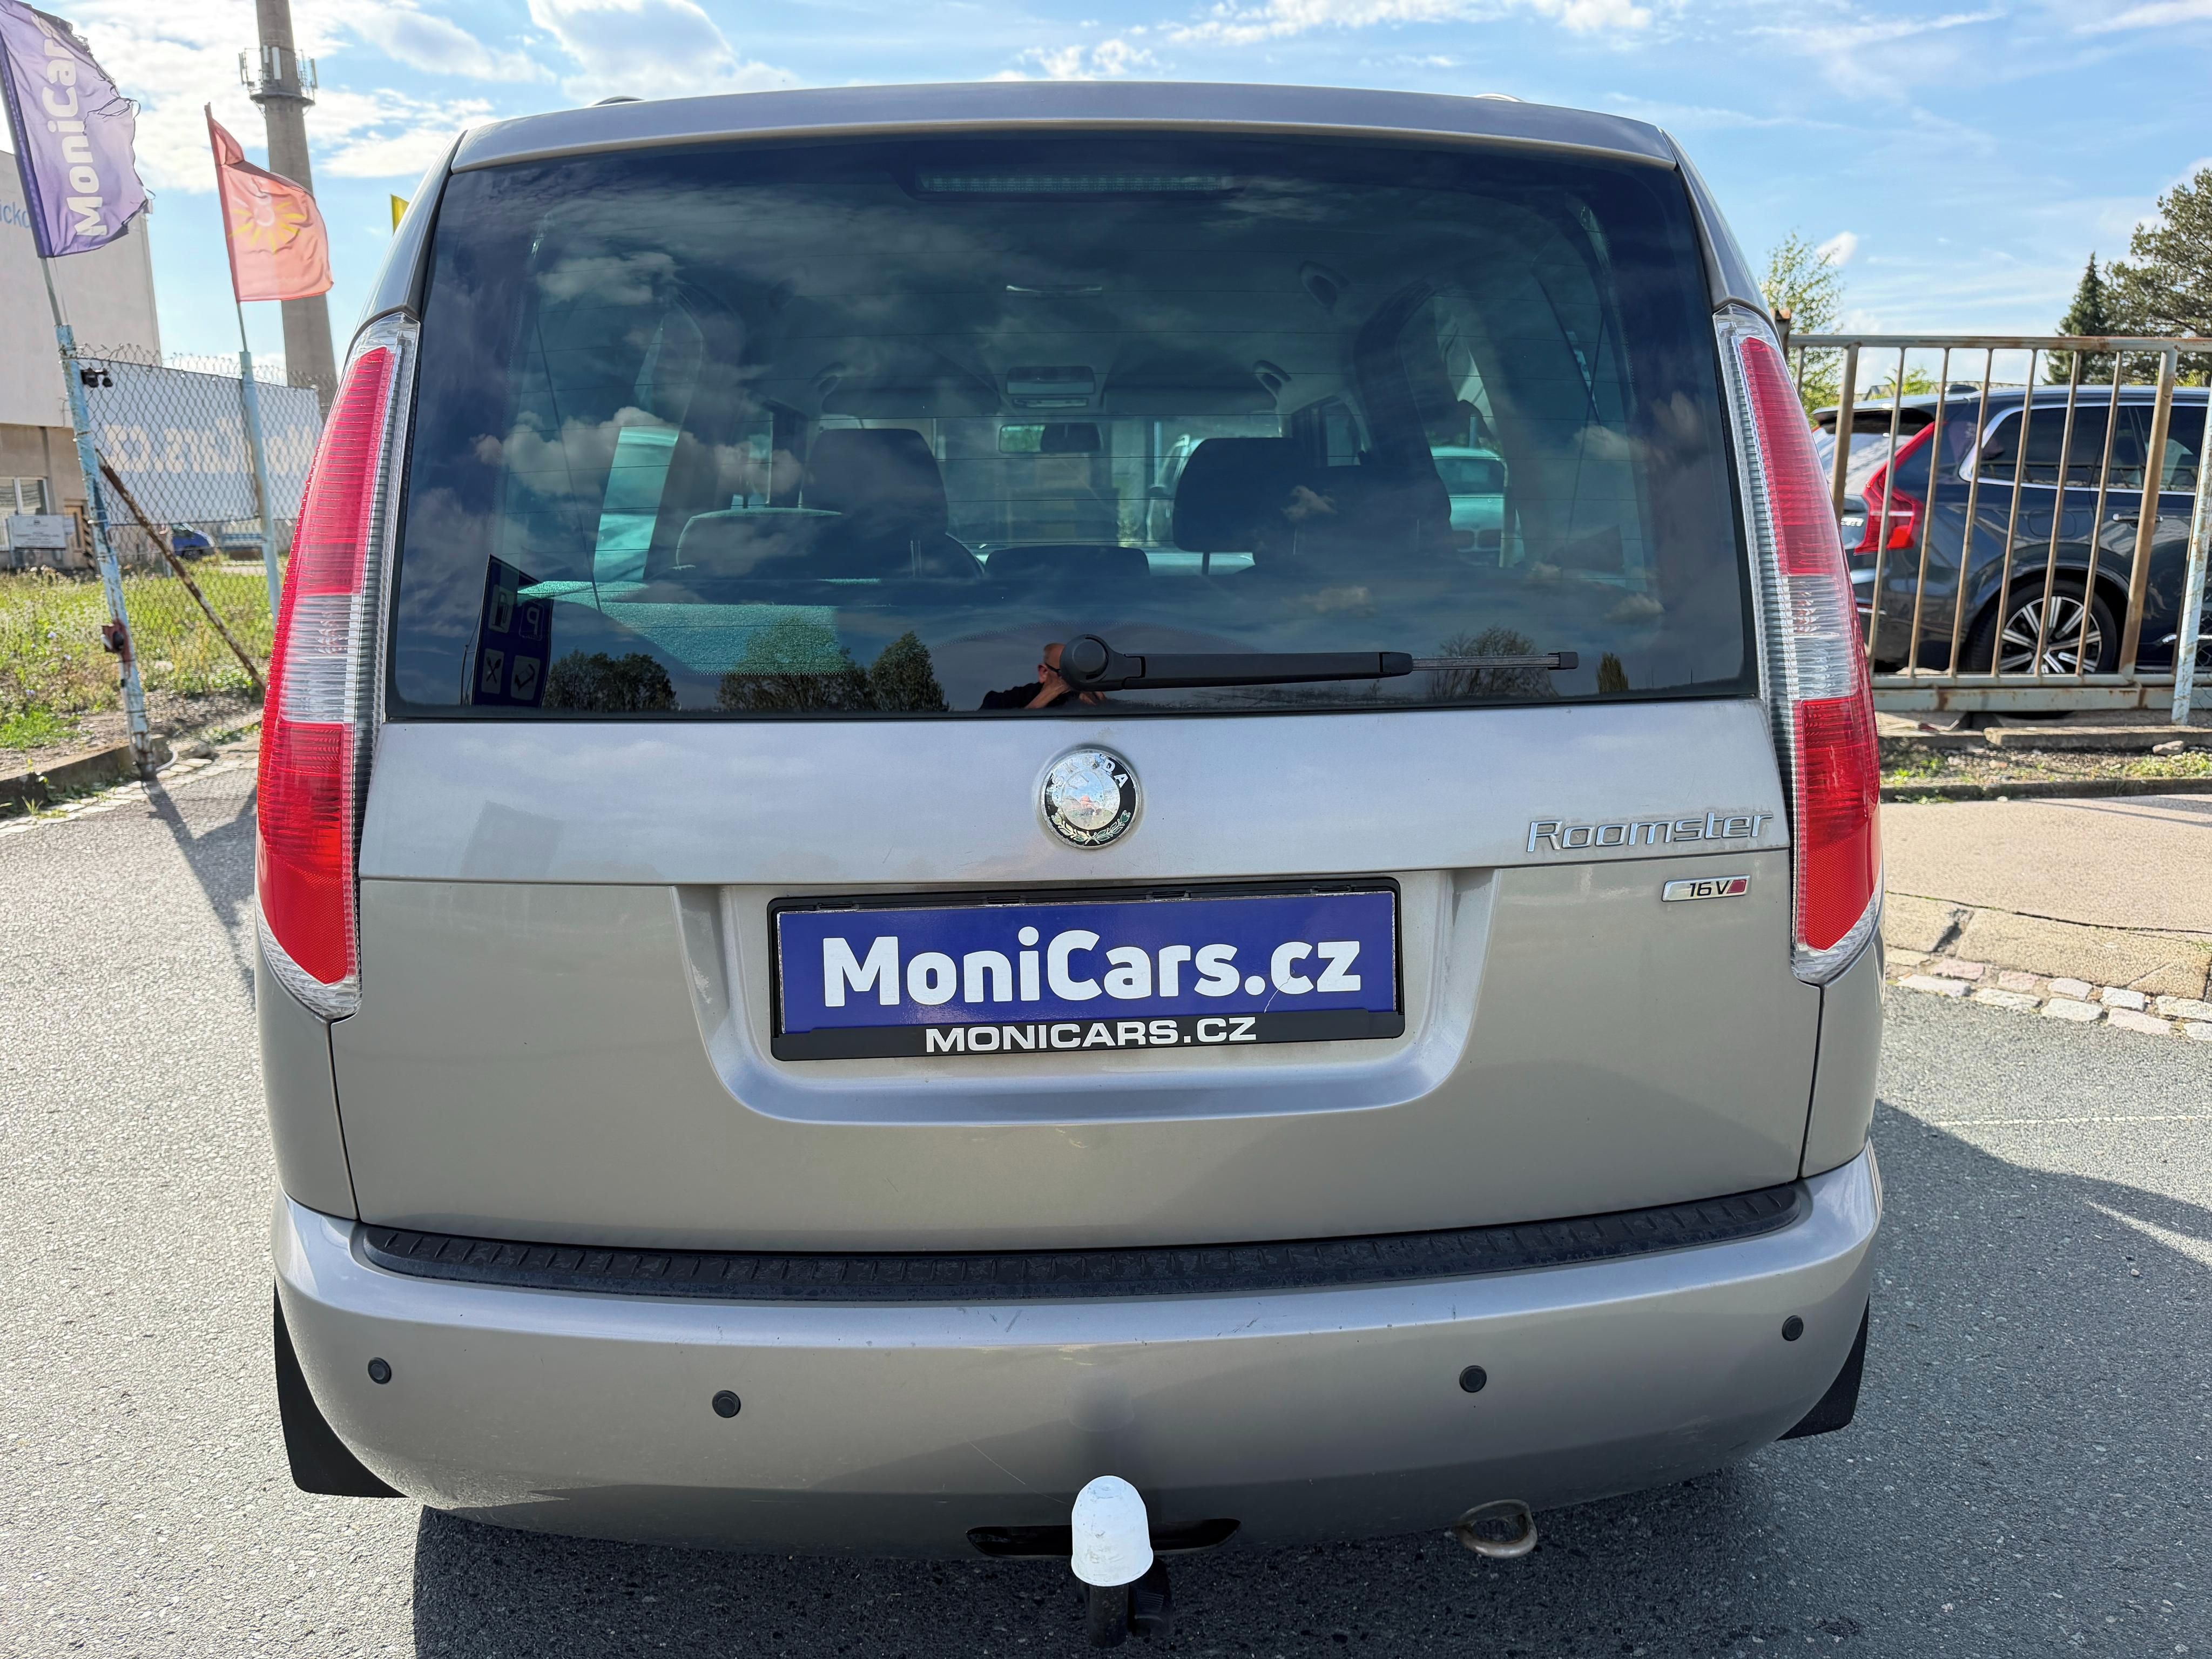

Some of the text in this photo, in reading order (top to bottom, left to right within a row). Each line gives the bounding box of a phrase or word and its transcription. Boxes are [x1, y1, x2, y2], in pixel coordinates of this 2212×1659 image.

[1526, 812, 1773, 852] Roomster
[1689, 881, 1730, 897] 16V
[822, 926, 1361, 1008] MoniCars.cz
[926, 1016, 1257, 1053] MONICARS.CZ
